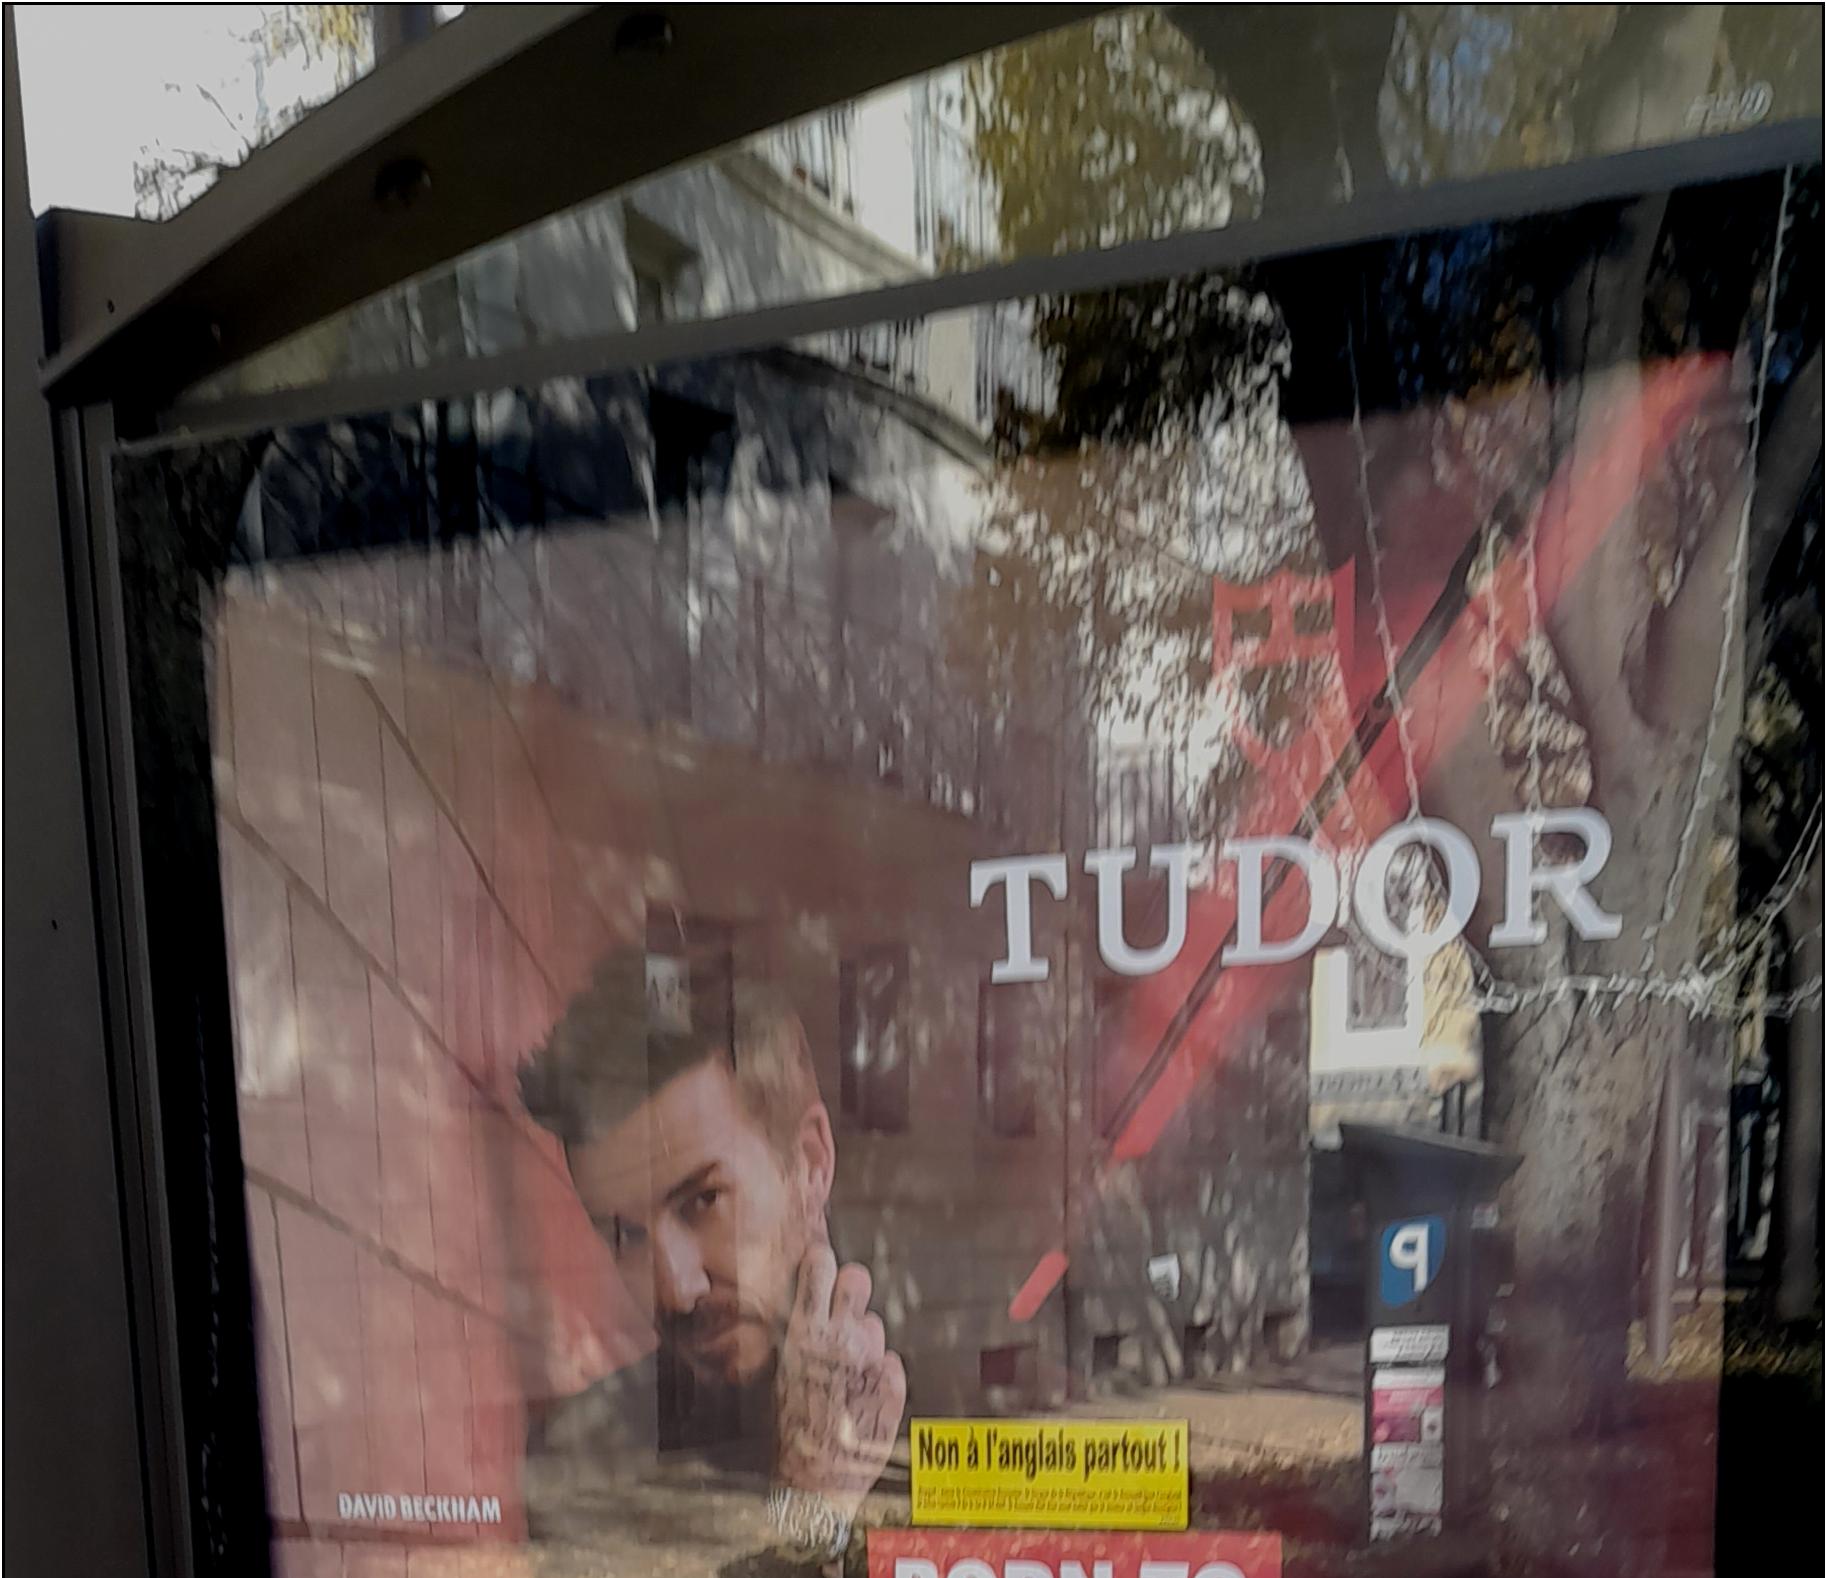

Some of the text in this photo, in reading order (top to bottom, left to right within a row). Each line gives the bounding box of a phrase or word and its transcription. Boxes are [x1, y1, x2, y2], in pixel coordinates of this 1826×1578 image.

[970, 806, 1622, 983] TUDOR
[919, 1428, 959, 1470] Non
[967, 1427, 978, 1470] à
[987, 1428, 1076, 1482] l'anglais
[1084, 1430, 1167, 1482] partout
[339, 1492, 501, 1523] DAVID BECKHAM
